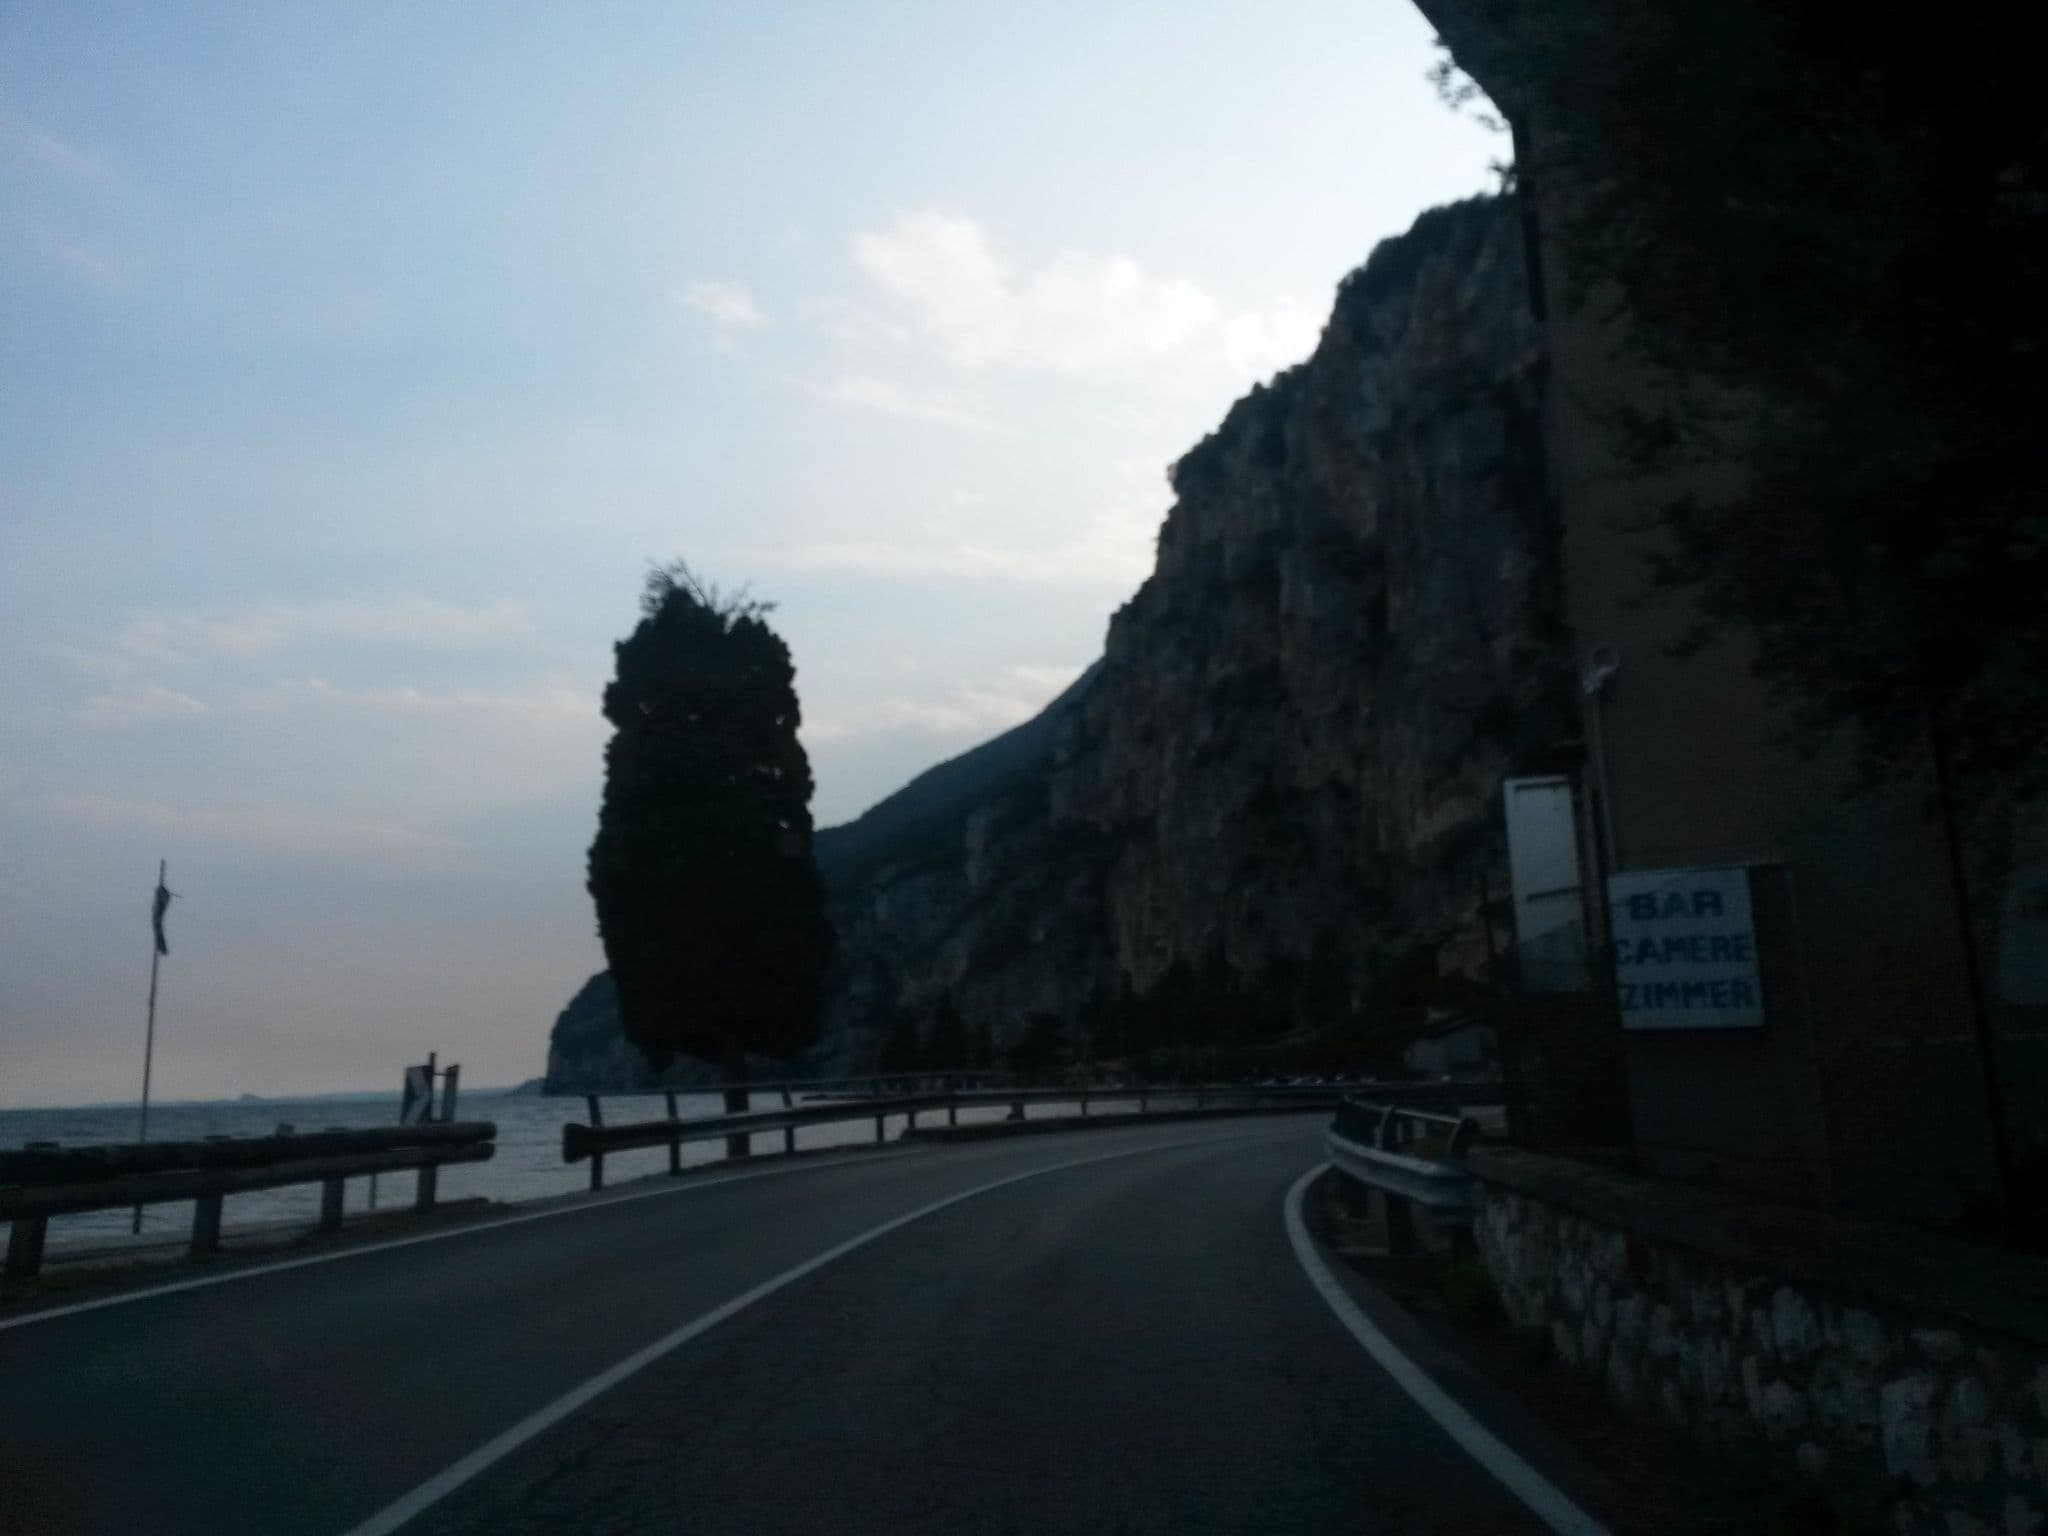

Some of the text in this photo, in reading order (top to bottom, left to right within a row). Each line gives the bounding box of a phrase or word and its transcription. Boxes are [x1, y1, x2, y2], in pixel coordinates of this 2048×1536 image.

[1629, 891, 1723, 920] BAR
[1615, 935, 1752, 965] CAMERE
[1622, 979, 1754, 1010] ZIMMER
